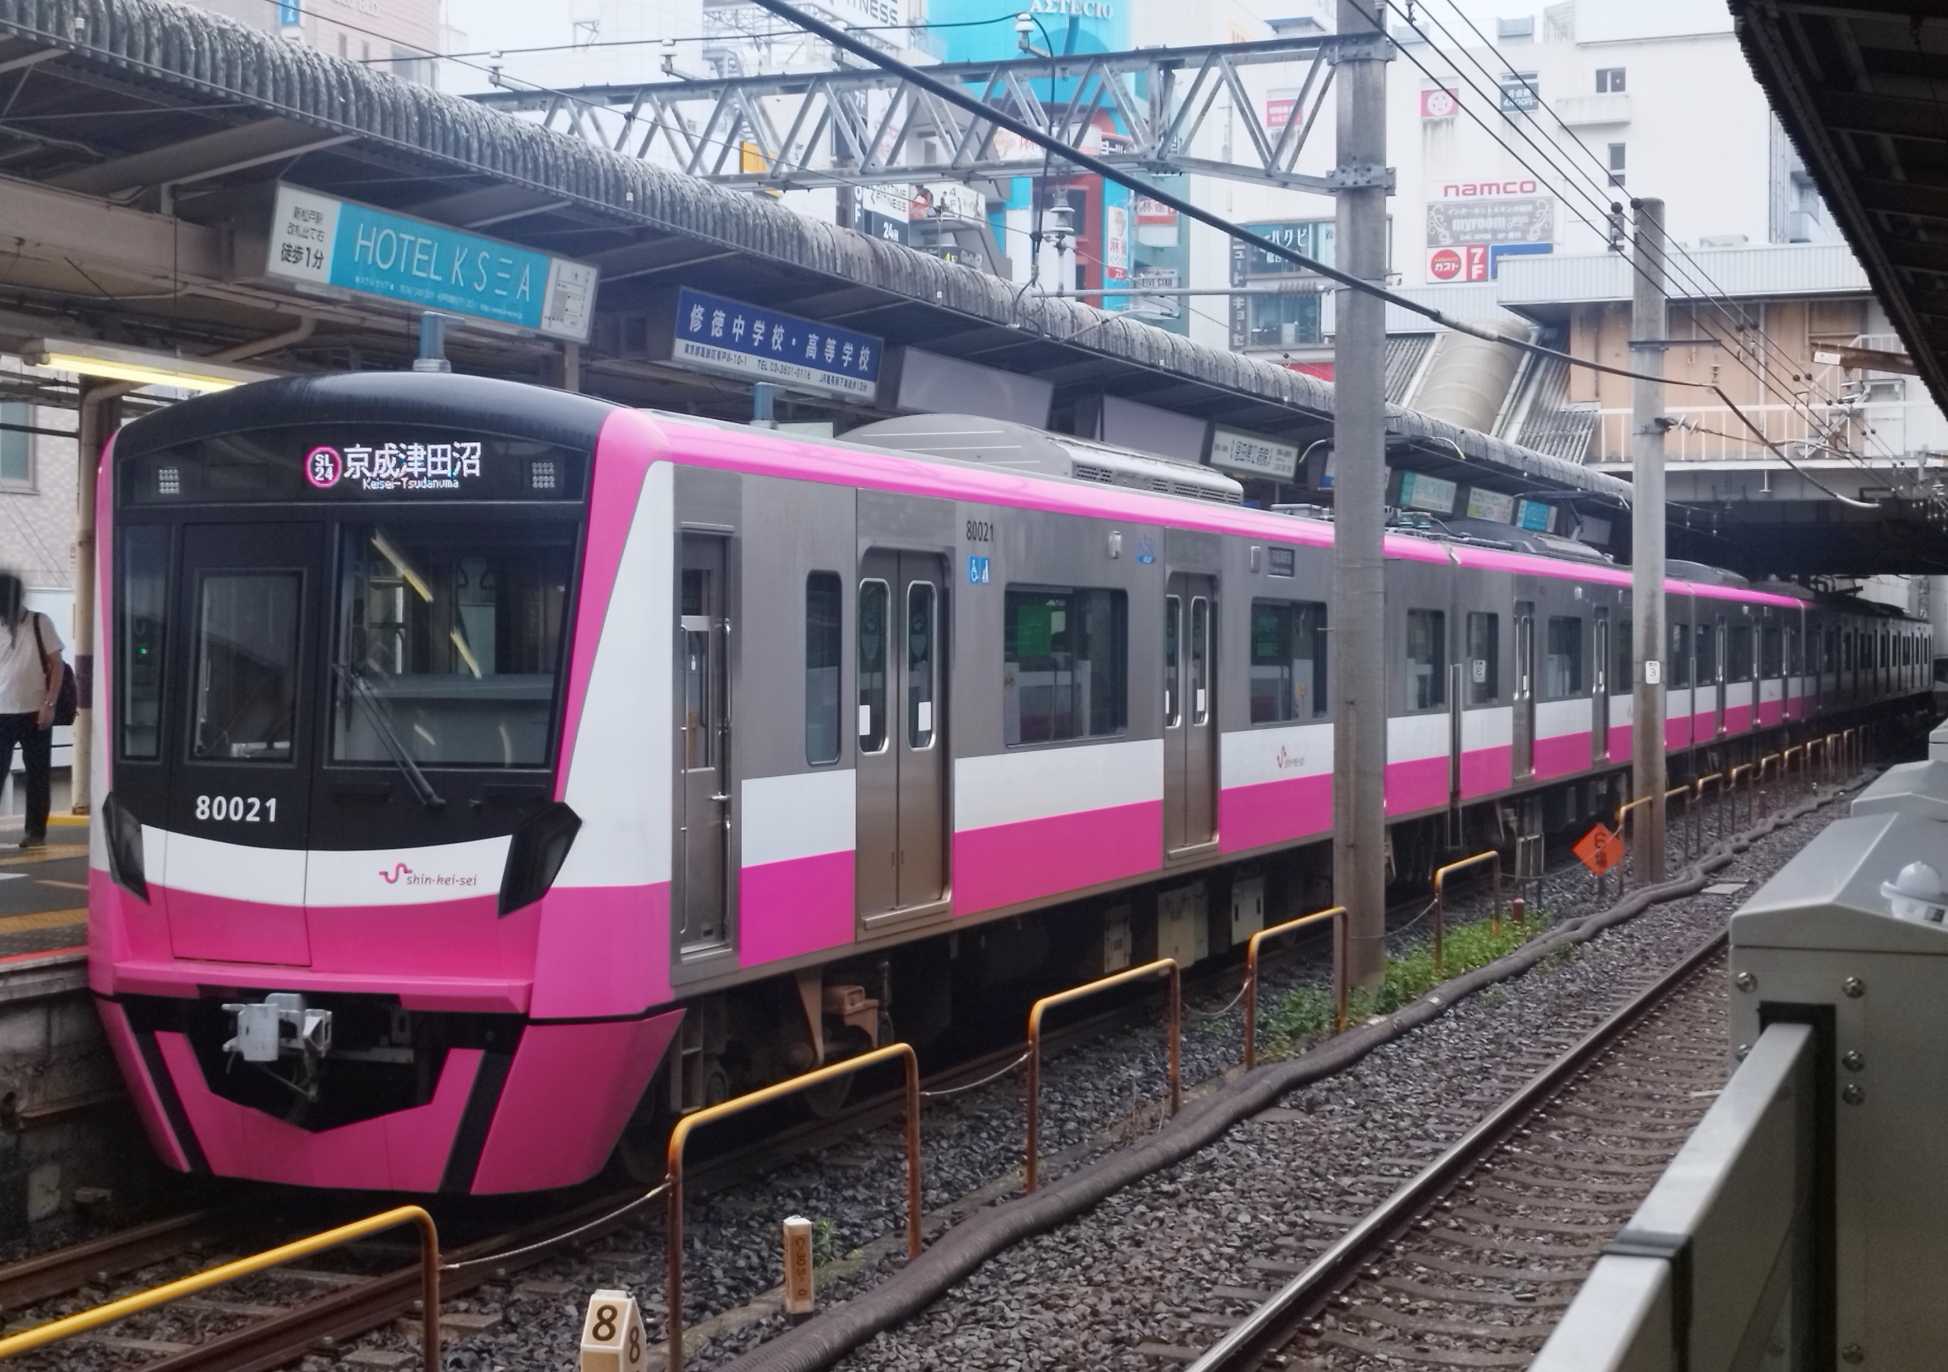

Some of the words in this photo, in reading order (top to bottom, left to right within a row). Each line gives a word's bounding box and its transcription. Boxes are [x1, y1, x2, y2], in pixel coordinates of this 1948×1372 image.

[1444, 181, 1536, 197] namco
[281, 242, 324, 269] 徒歩1分
[354, 223, 442, 281] HOTEL
[689, 303, 870, 371] 修徳中学校・高等学校
[314, 453, 334, 467] SL
[343, 442, 482, 478] 京成津田沼
[314, 467, 334, 481] 24
[362, 477, 460, 490] Keisei-Tsudanuma
[966, 520, 994, 542] 80021
[195, 795, 277, 822] 80021
[407, 873, 478, 886] shin-kei-sei
[592, 1304, 618, 1342] 8
[629, 1326, 641, 1364] 8
